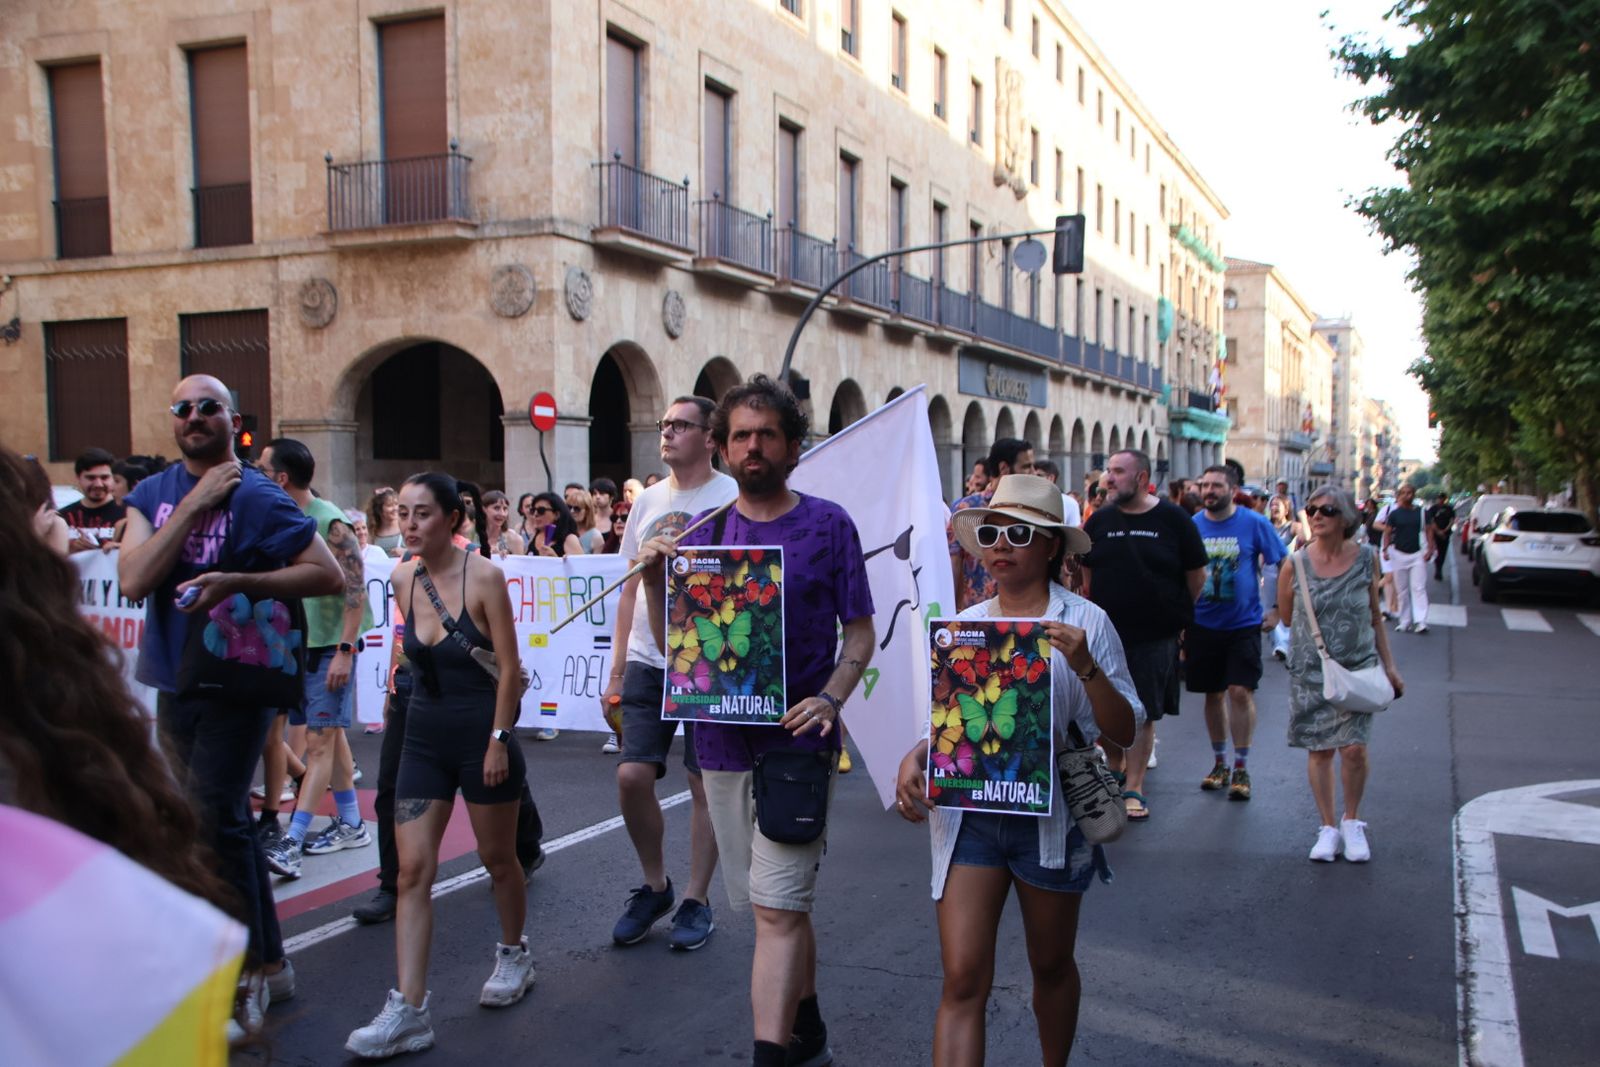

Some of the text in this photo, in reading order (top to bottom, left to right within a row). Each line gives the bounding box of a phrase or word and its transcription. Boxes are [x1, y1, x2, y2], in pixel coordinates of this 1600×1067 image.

[954, 630, 985, 638] PACMA
[561, 655, 604, 697] ADEL
[671, 686, 682, 695] LA
[671, 695, 720, 704] DIVERSIDAD
[710, 695, 778, 715] ES NATURAL
[934, 768, 945, 777] LA
[934, 777, 983, 789] DIVERSIDAD
[972, 780, 1043, 804] ES NATURAL
